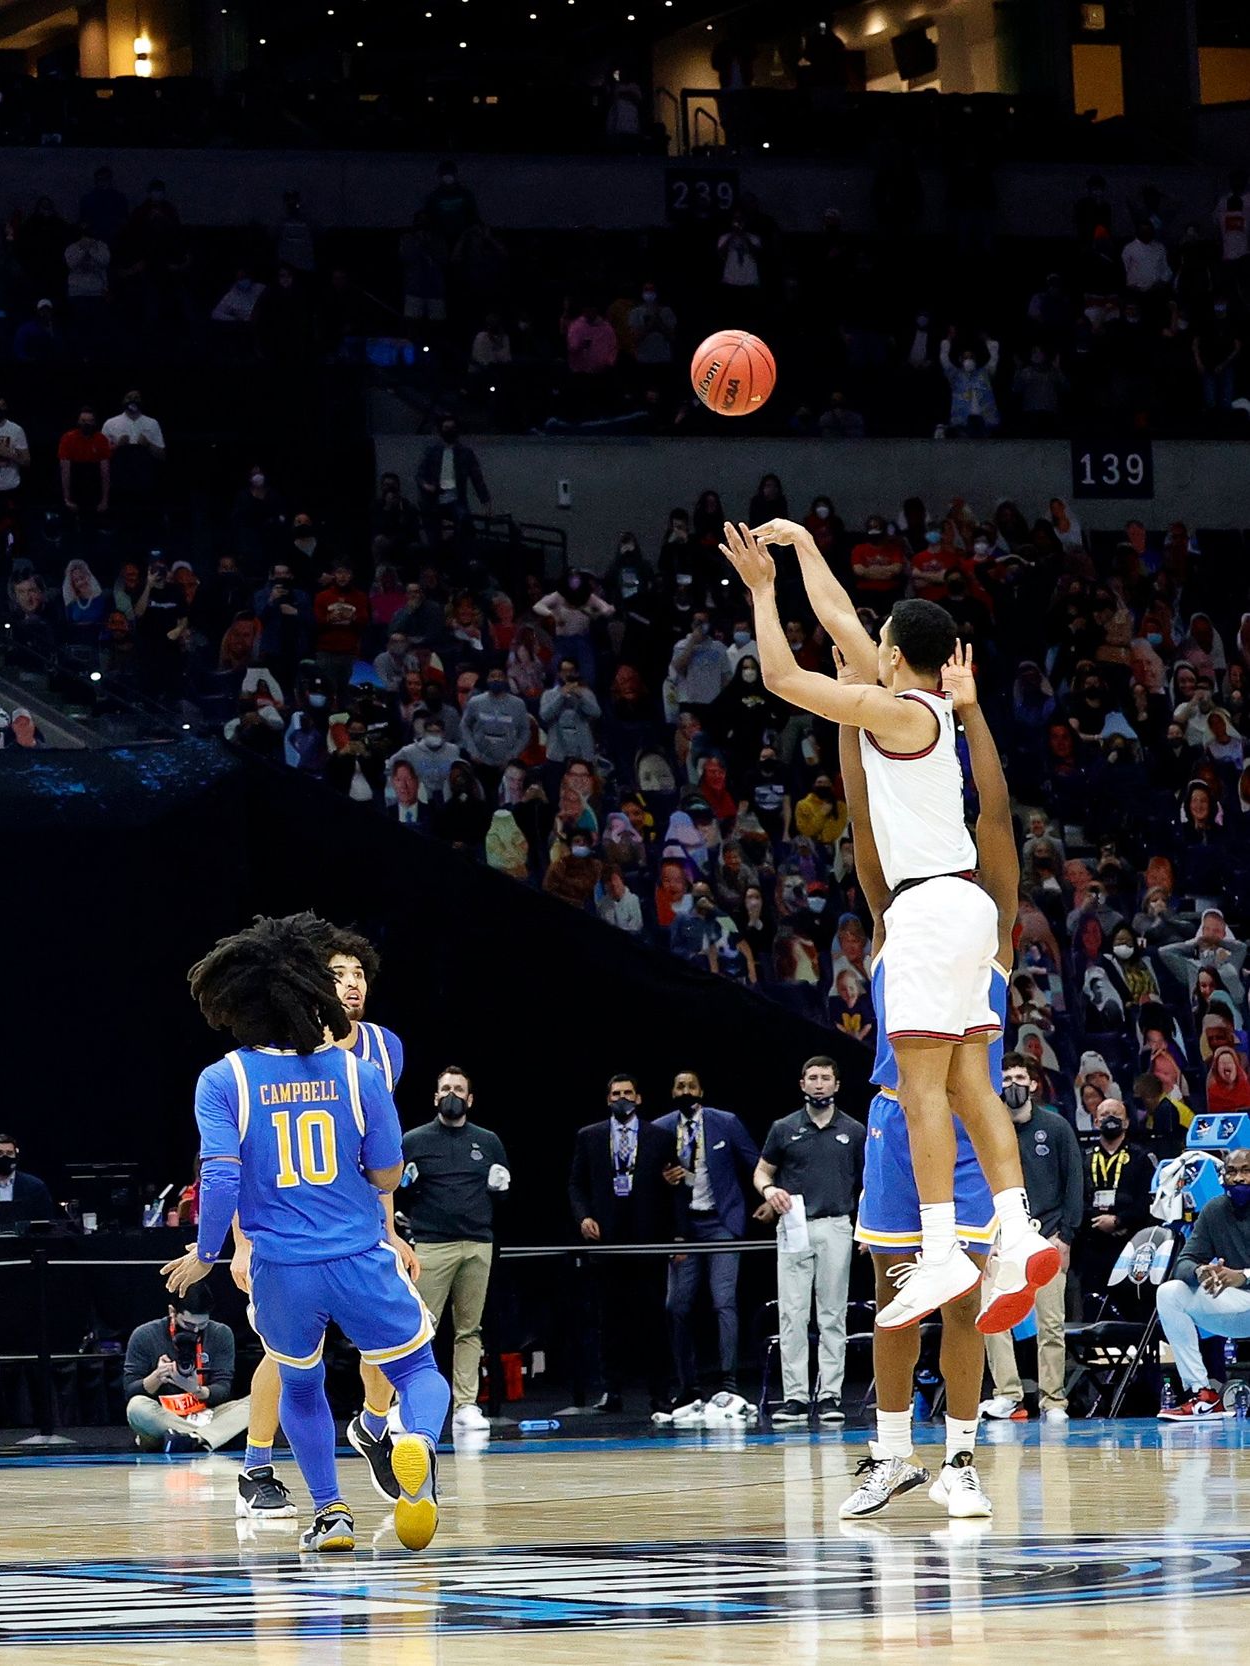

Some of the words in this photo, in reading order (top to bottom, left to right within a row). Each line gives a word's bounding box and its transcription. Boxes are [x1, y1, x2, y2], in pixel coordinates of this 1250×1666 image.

[1080, 453, 1144, 486] 139
[259, 1080, 340, 1105] CAMPBELL
[271, 1109, 338, 1189] 10
